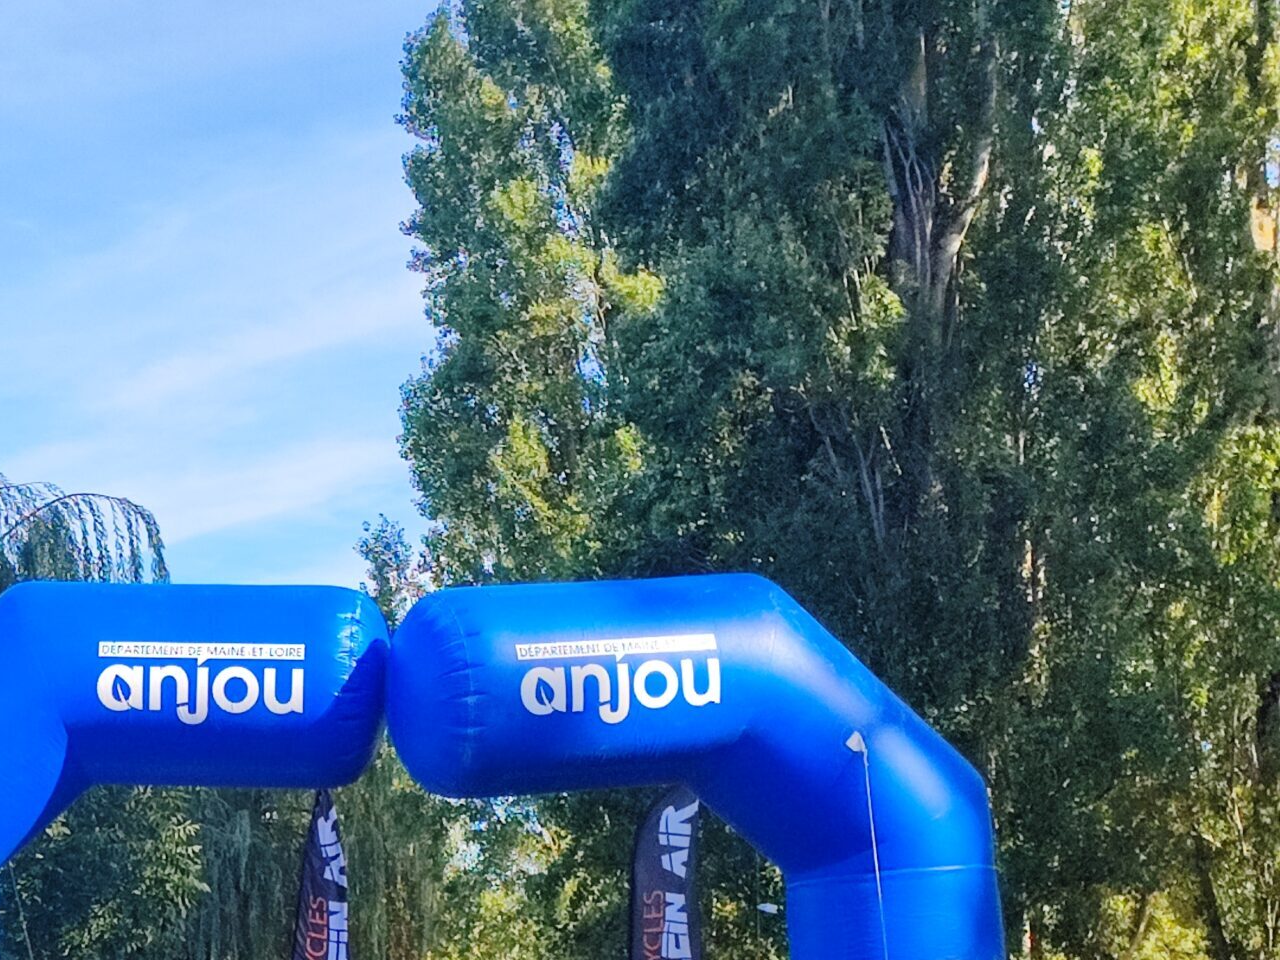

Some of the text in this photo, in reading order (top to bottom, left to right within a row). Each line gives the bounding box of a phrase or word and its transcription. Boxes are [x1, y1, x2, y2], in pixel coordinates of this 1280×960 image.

[188, 645, 202, 656] DE
[603, 642, 619, 653] DE
[97, 663, 304, 725] anjou
[521, 658, 720, 724] anjou
